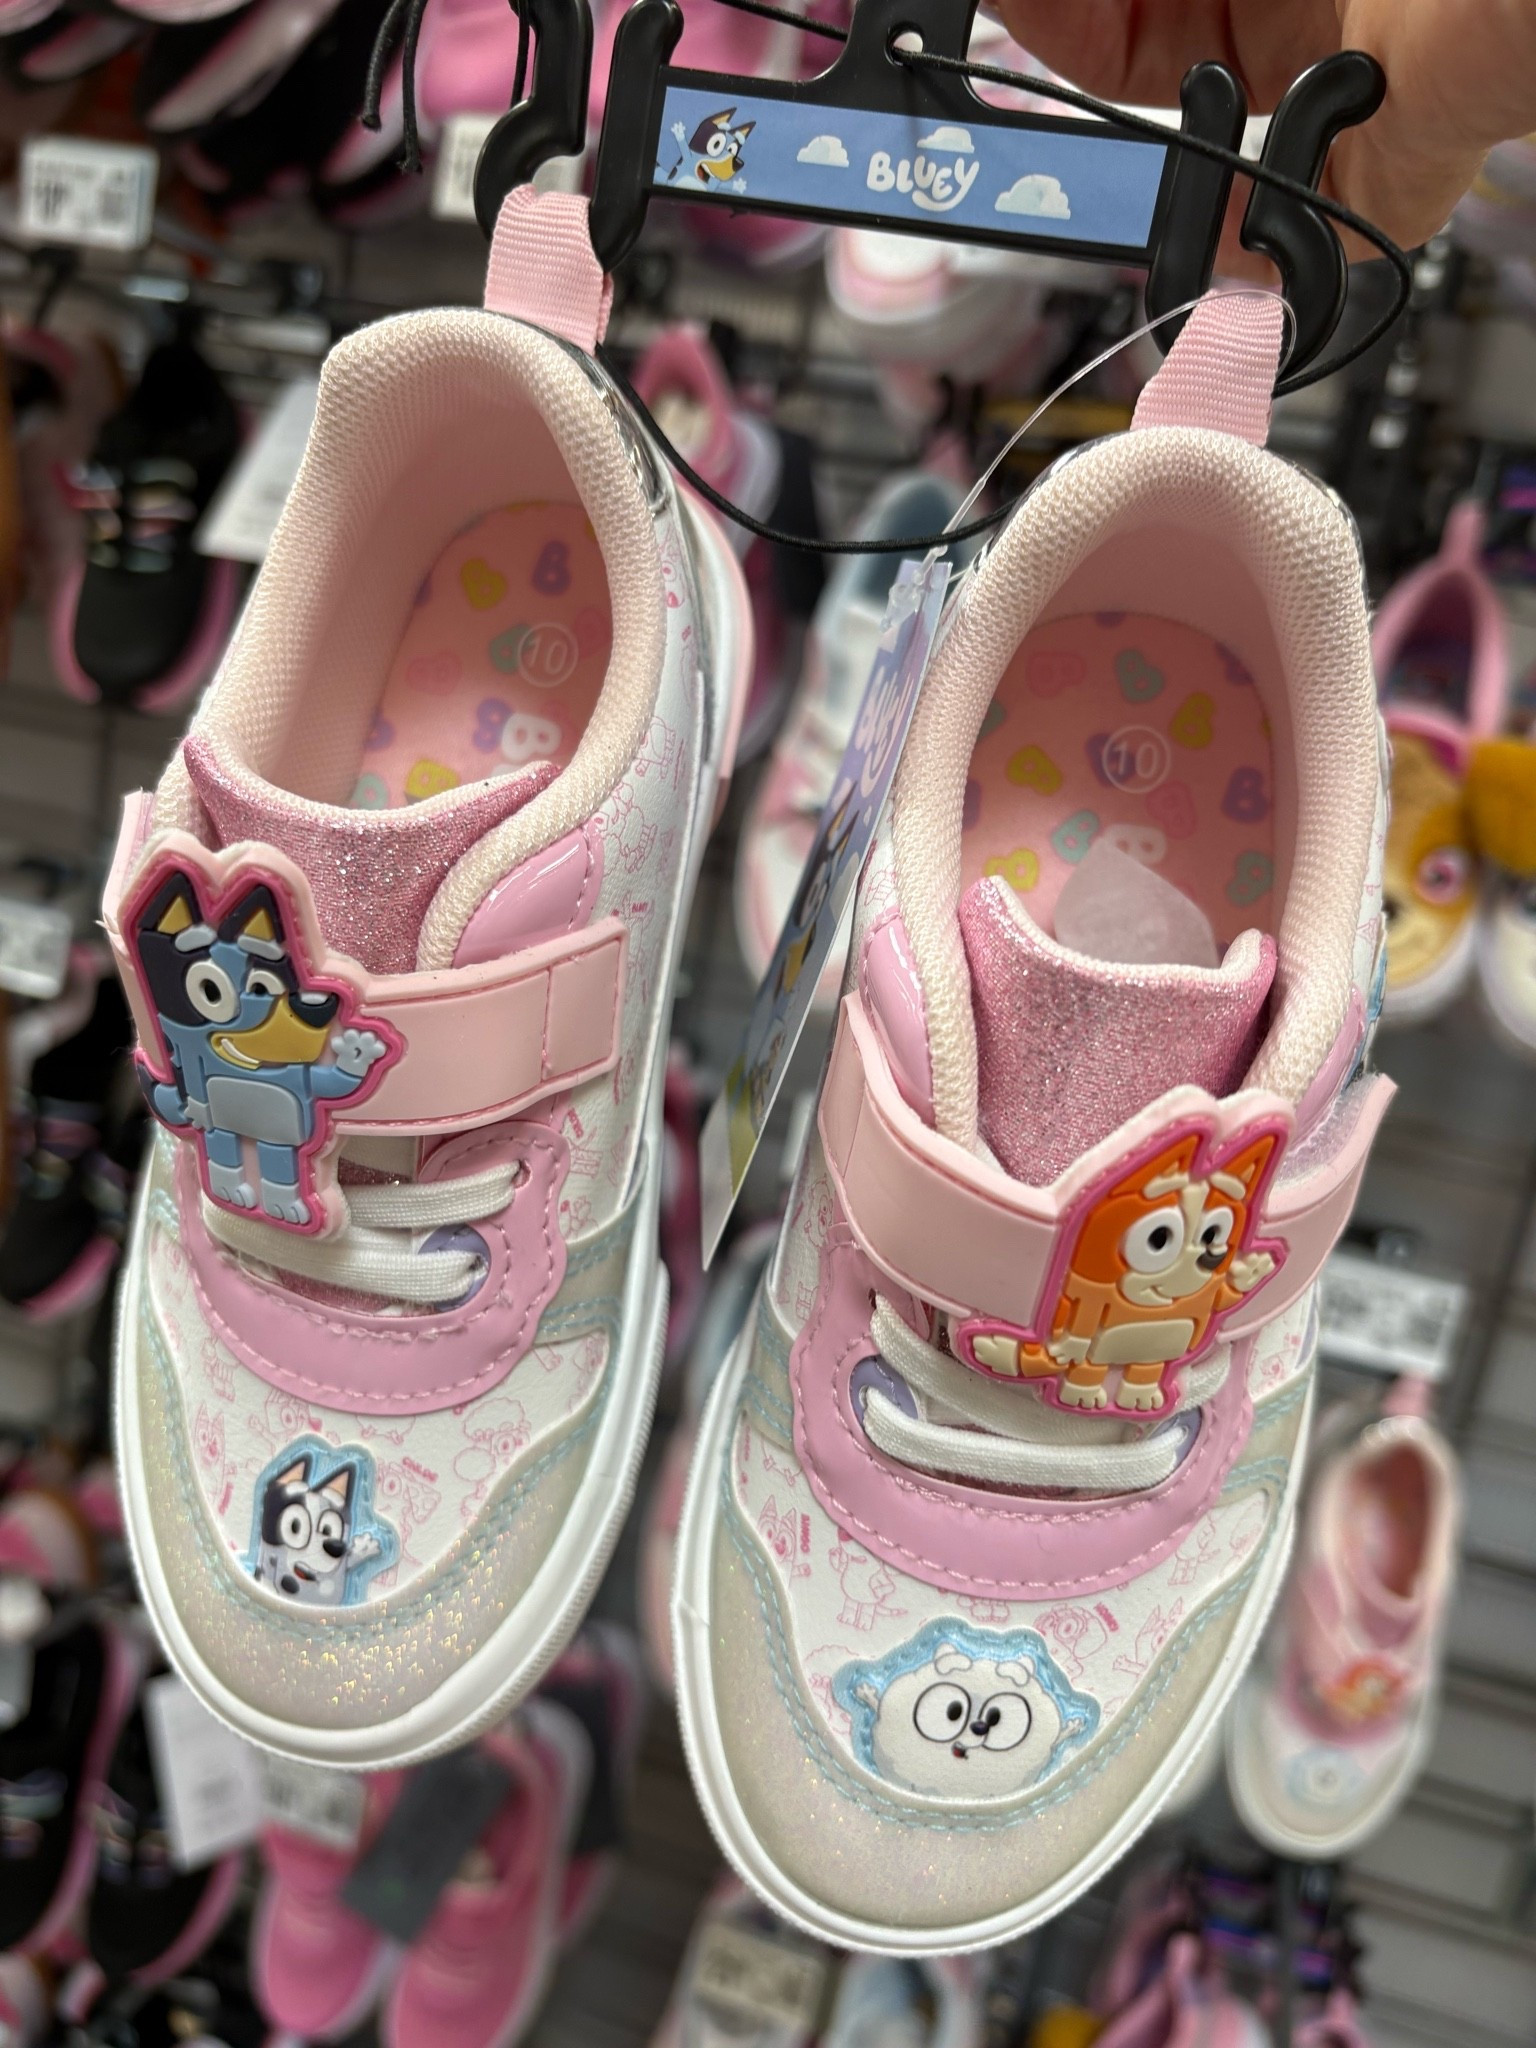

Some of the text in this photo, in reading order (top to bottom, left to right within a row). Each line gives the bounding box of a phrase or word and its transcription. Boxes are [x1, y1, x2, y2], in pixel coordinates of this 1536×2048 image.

[866, 151, 980, 212] BLUEY
[527, 634, 569, 676] 10
[1111, 740, 1160, 780] 10
